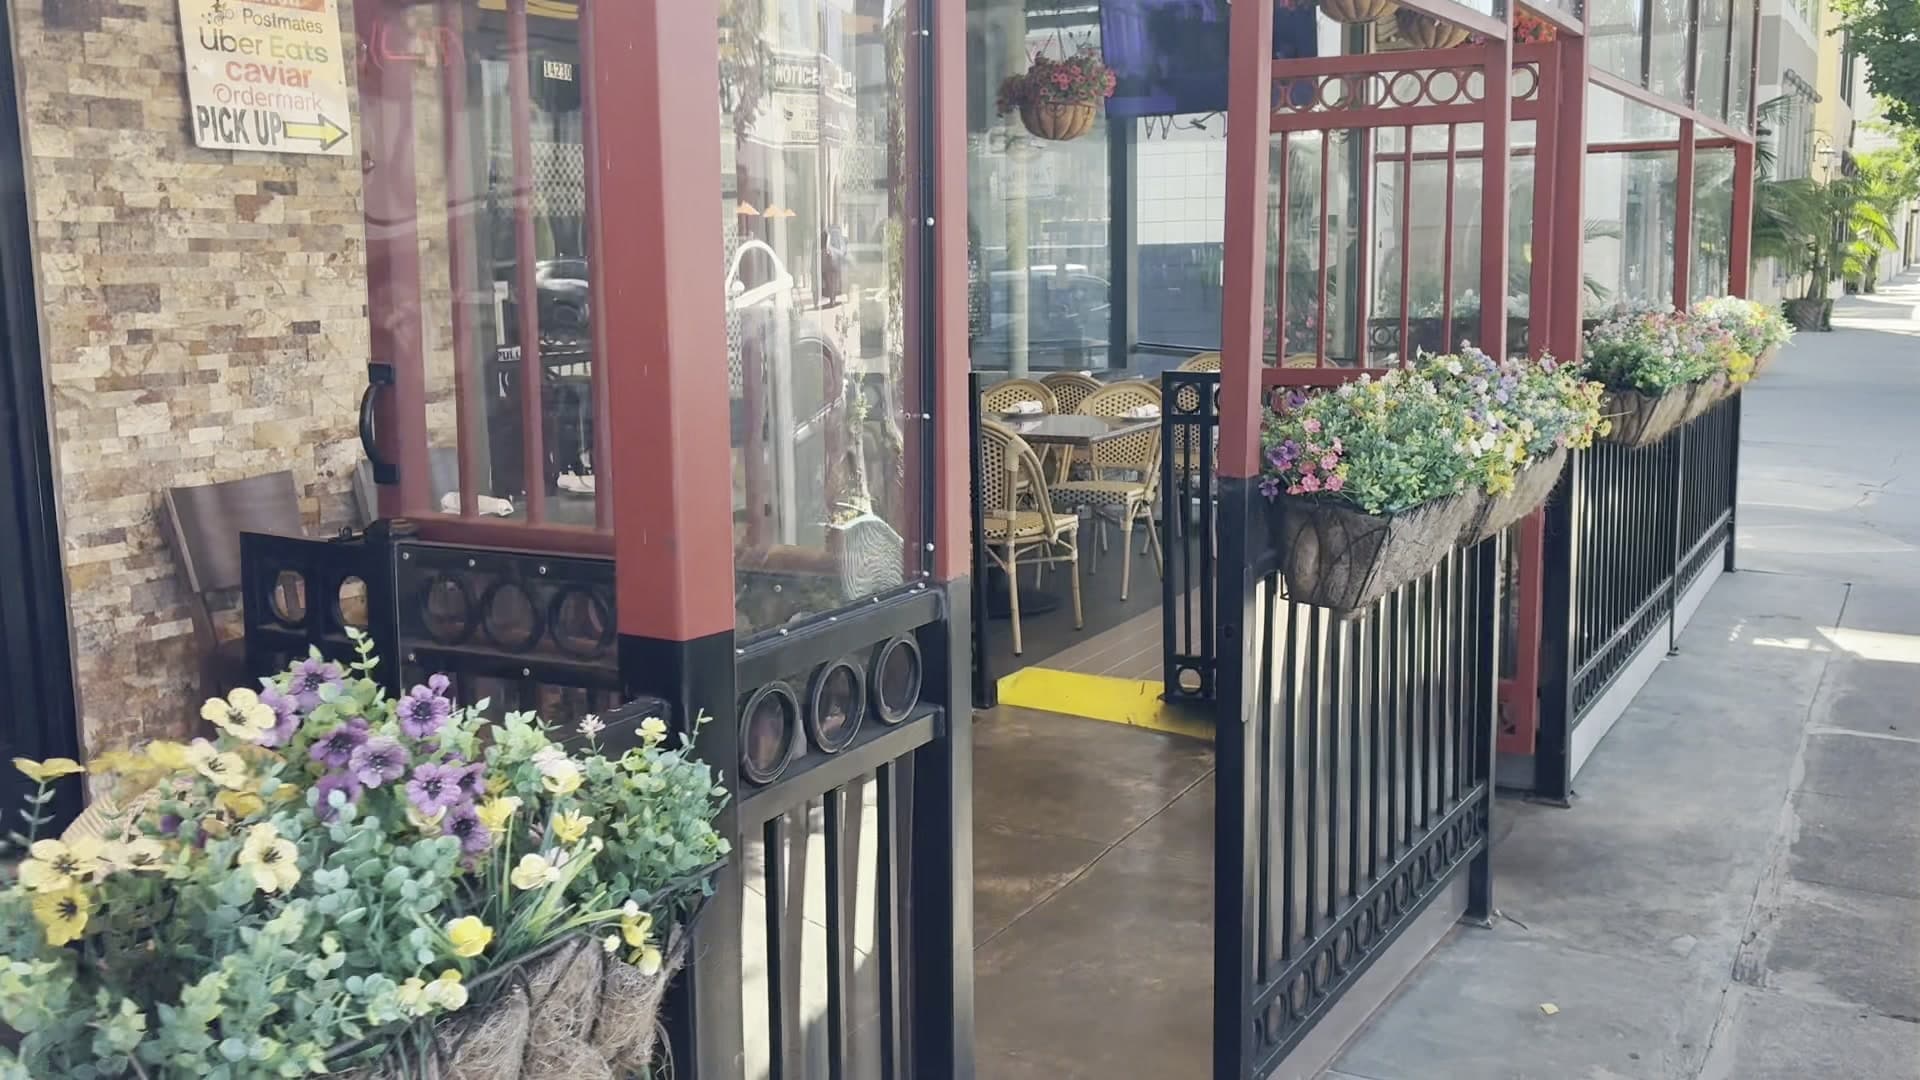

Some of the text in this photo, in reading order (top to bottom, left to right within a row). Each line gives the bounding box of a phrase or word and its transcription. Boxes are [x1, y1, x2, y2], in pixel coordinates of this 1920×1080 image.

[242, 8, 324, 34] Postmates
[199, 27, 329, 63] Uber Eats
[225, 60, 313, 88] caviar
[213, 83, 323, 111] Ordermark
[197, 105, 282, 146] PICK UP
